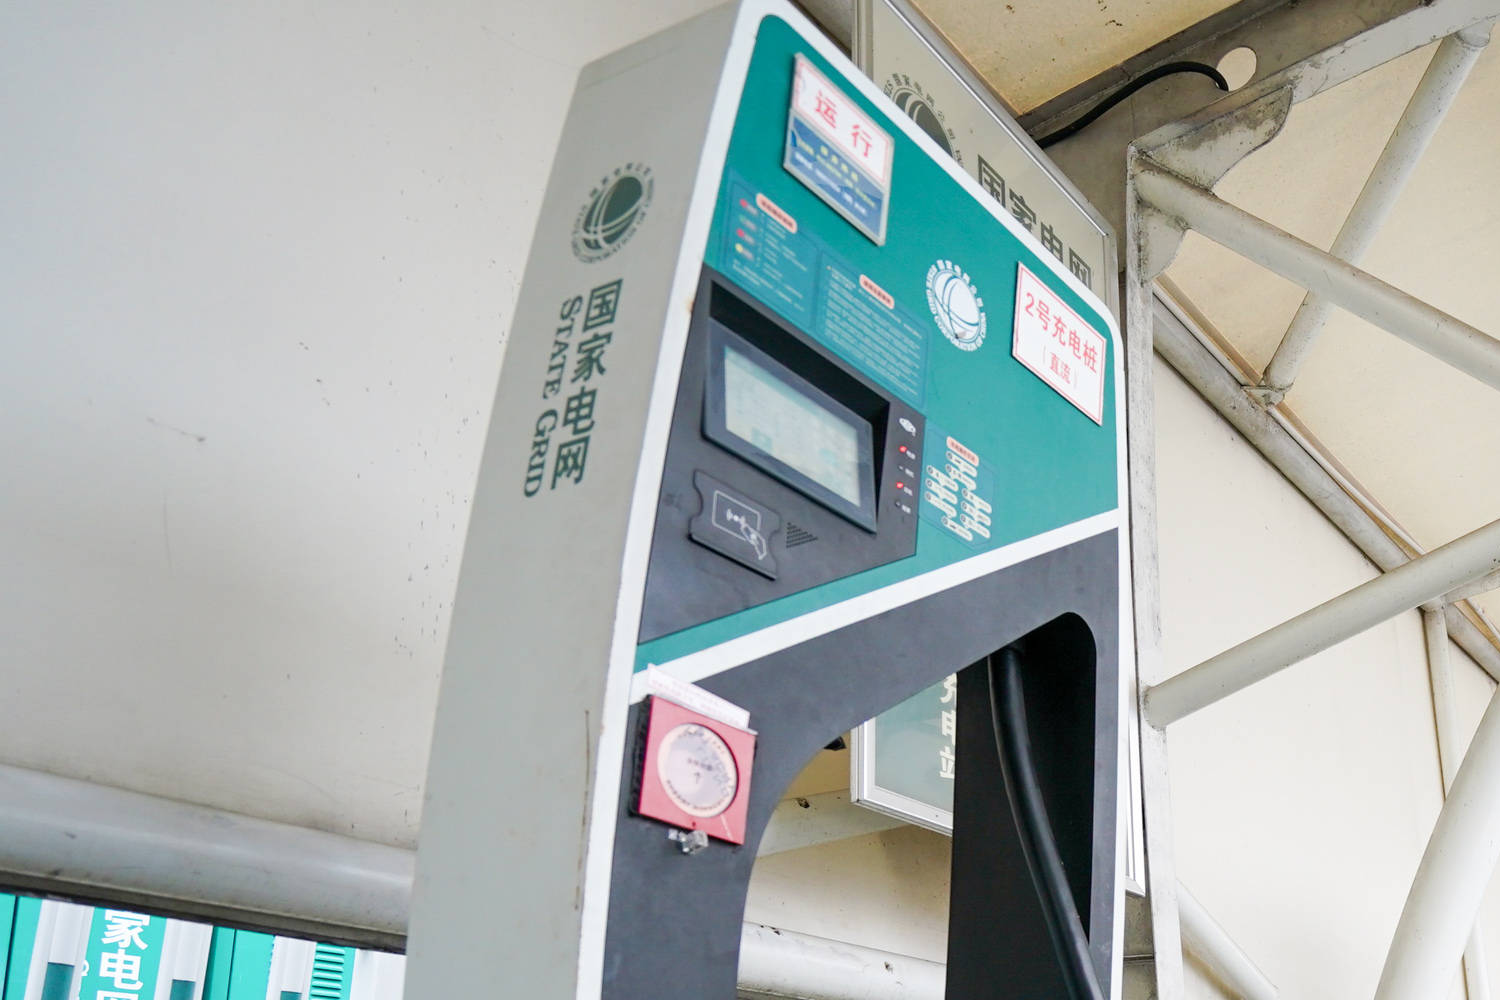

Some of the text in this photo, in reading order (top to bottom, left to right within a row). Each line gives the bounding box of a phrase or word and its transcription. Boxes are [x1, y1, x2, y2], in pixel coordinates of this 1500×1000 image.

[815, 89, 873, 158] 运行
[523, 295, 583, 498] STATE GRID
[549, 278, 623, 491] 国家电网
[1024, 291, 1098, 374] 2号充电桩
